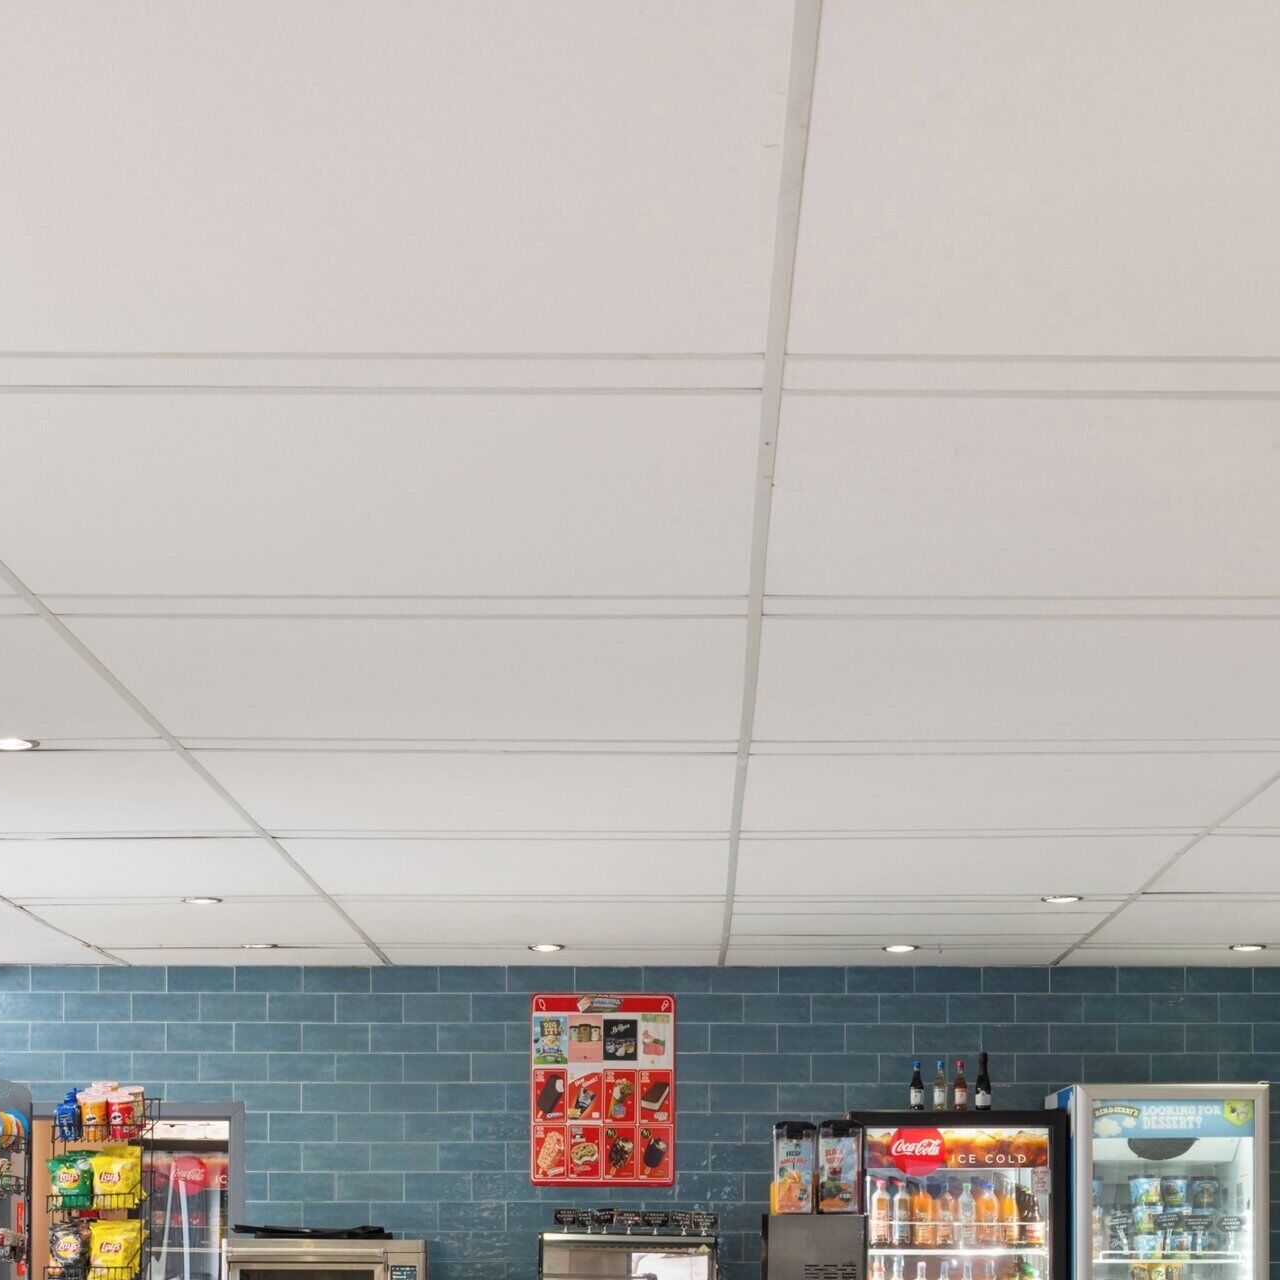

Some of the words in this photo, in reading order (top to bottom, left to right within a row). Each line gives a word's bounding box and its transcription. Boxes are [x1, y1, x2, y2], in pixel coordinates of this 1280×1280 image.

[1141, 1105, 1194, 1116] LOOKING
[1197, 1105, 1222, 1116] FOR
[1141, 1116, 1203, 1130] DESSERT?
[951, 1154, 977, 1164] ICE
[985, 1154, 1027, 1164] COLD
